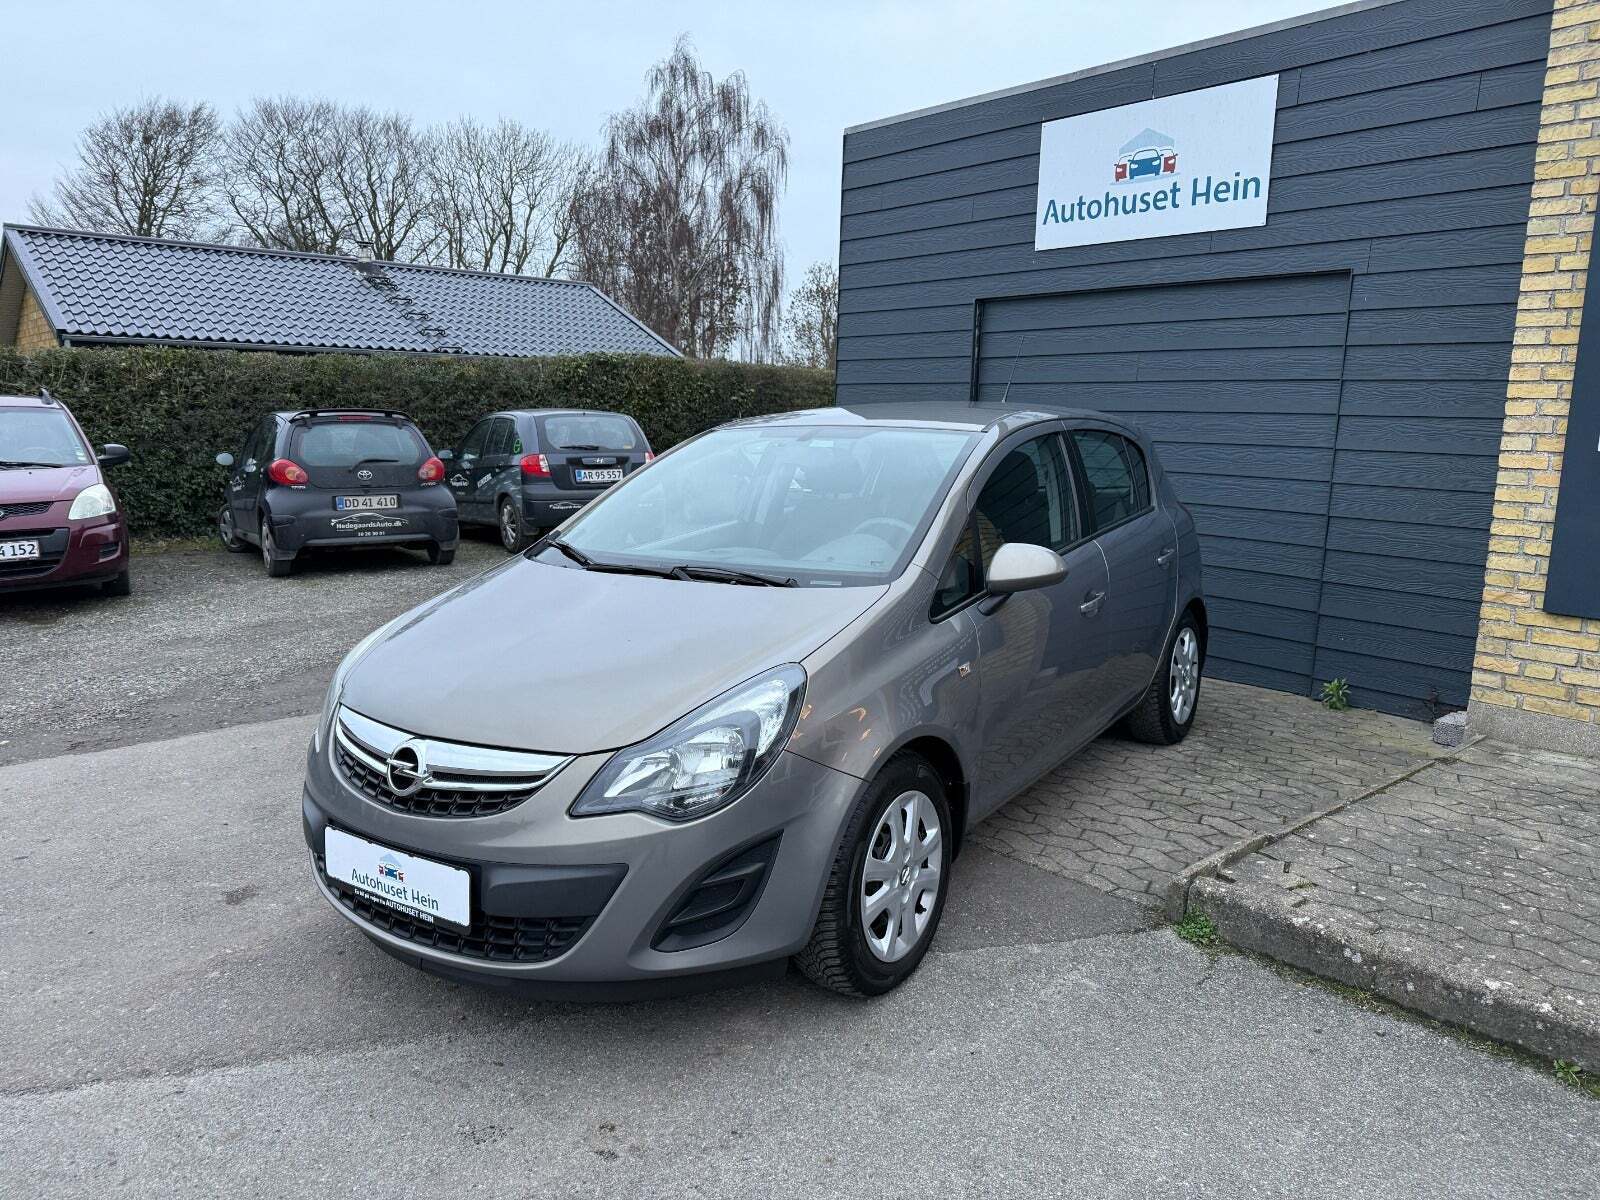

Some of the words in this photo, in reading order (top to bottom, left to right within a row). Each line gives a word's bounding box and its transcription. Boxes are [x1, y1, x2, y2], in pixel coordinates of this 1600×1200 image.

[1042, 181, 1181, 225] Autohuset
[1191, 171, 1262, 206] Hein
[583, 471, 594, 480] AR
[595, 471, 606, 480] 95
[607, 470, 621, 479] 557
[344, 498, 360, 508] DD
[362, 497, 373, 508] 41
[376, 496, 396, 507] 410
[10, 543, 37, 557] 152
[351, 868, 408, 901] Autohuset
[411, 888, 439, 911] Hein
[385, 899, 419, 917] AUTOHUSET
[419, 911, 434, 924] HEIN
